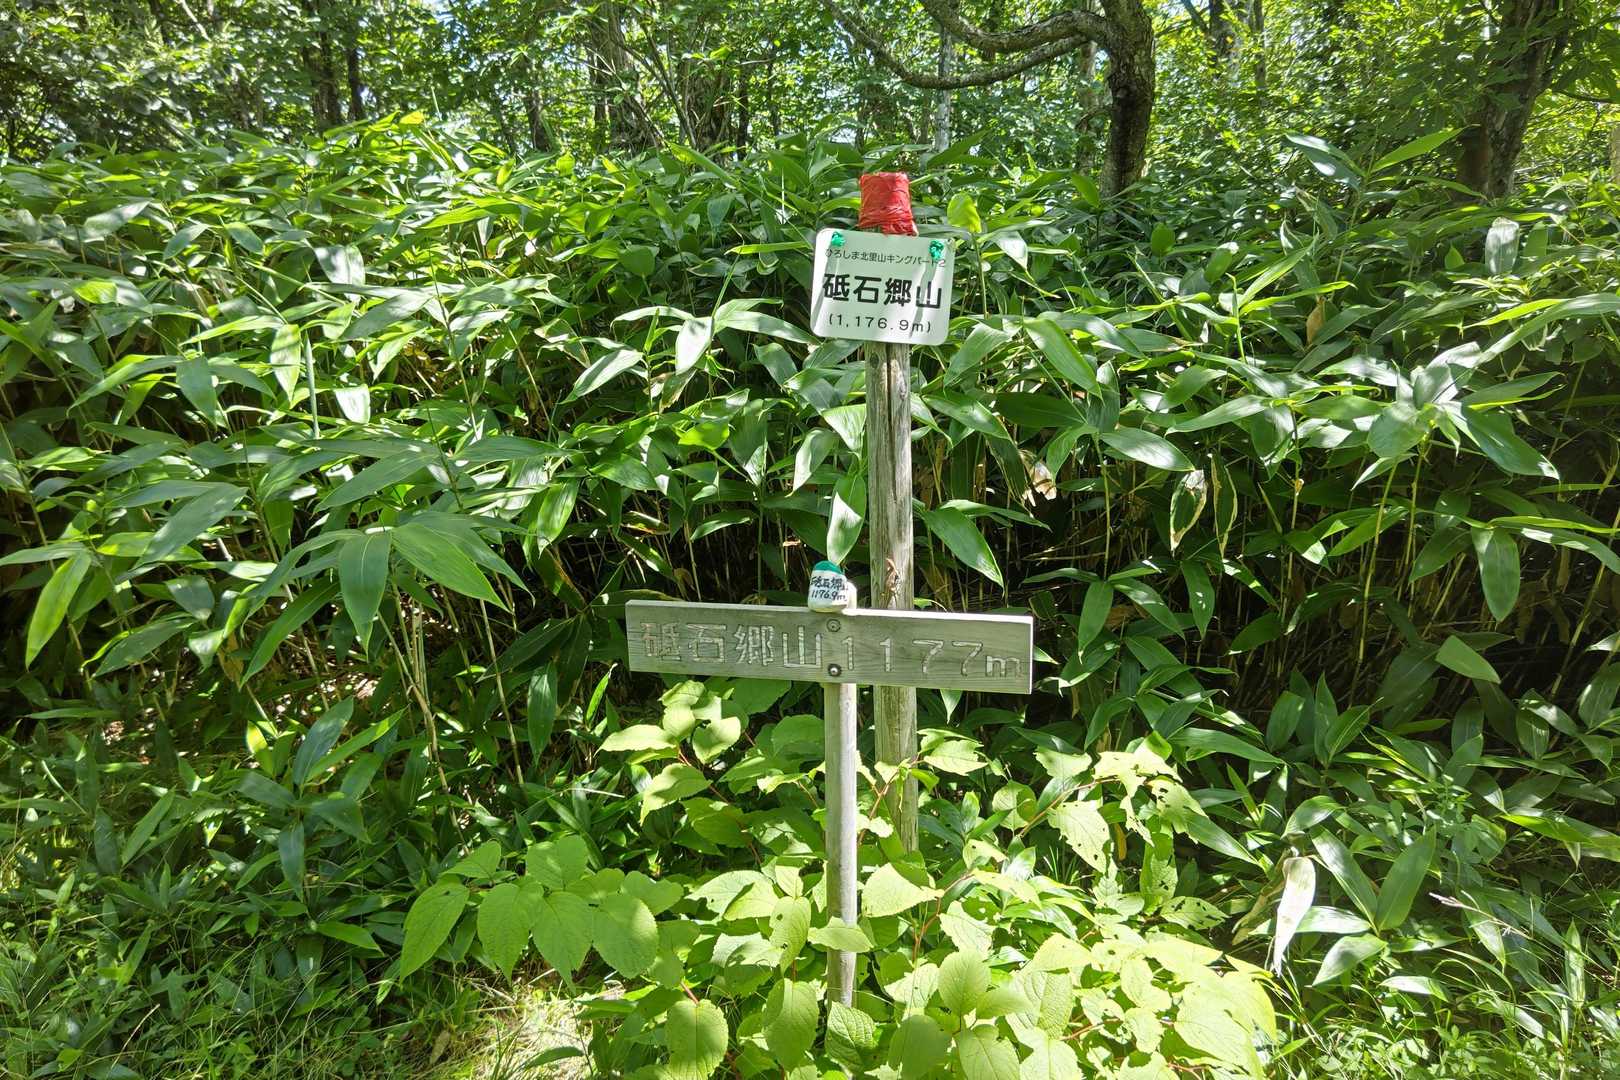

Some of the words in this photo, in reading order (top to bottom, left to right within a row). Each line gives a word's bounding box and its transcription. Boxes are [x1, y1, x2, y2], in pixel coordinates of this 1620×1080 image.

[822, 273, 942, 309] 砥石郷山
[829, 313, 931, 333] (1,176.9m)
